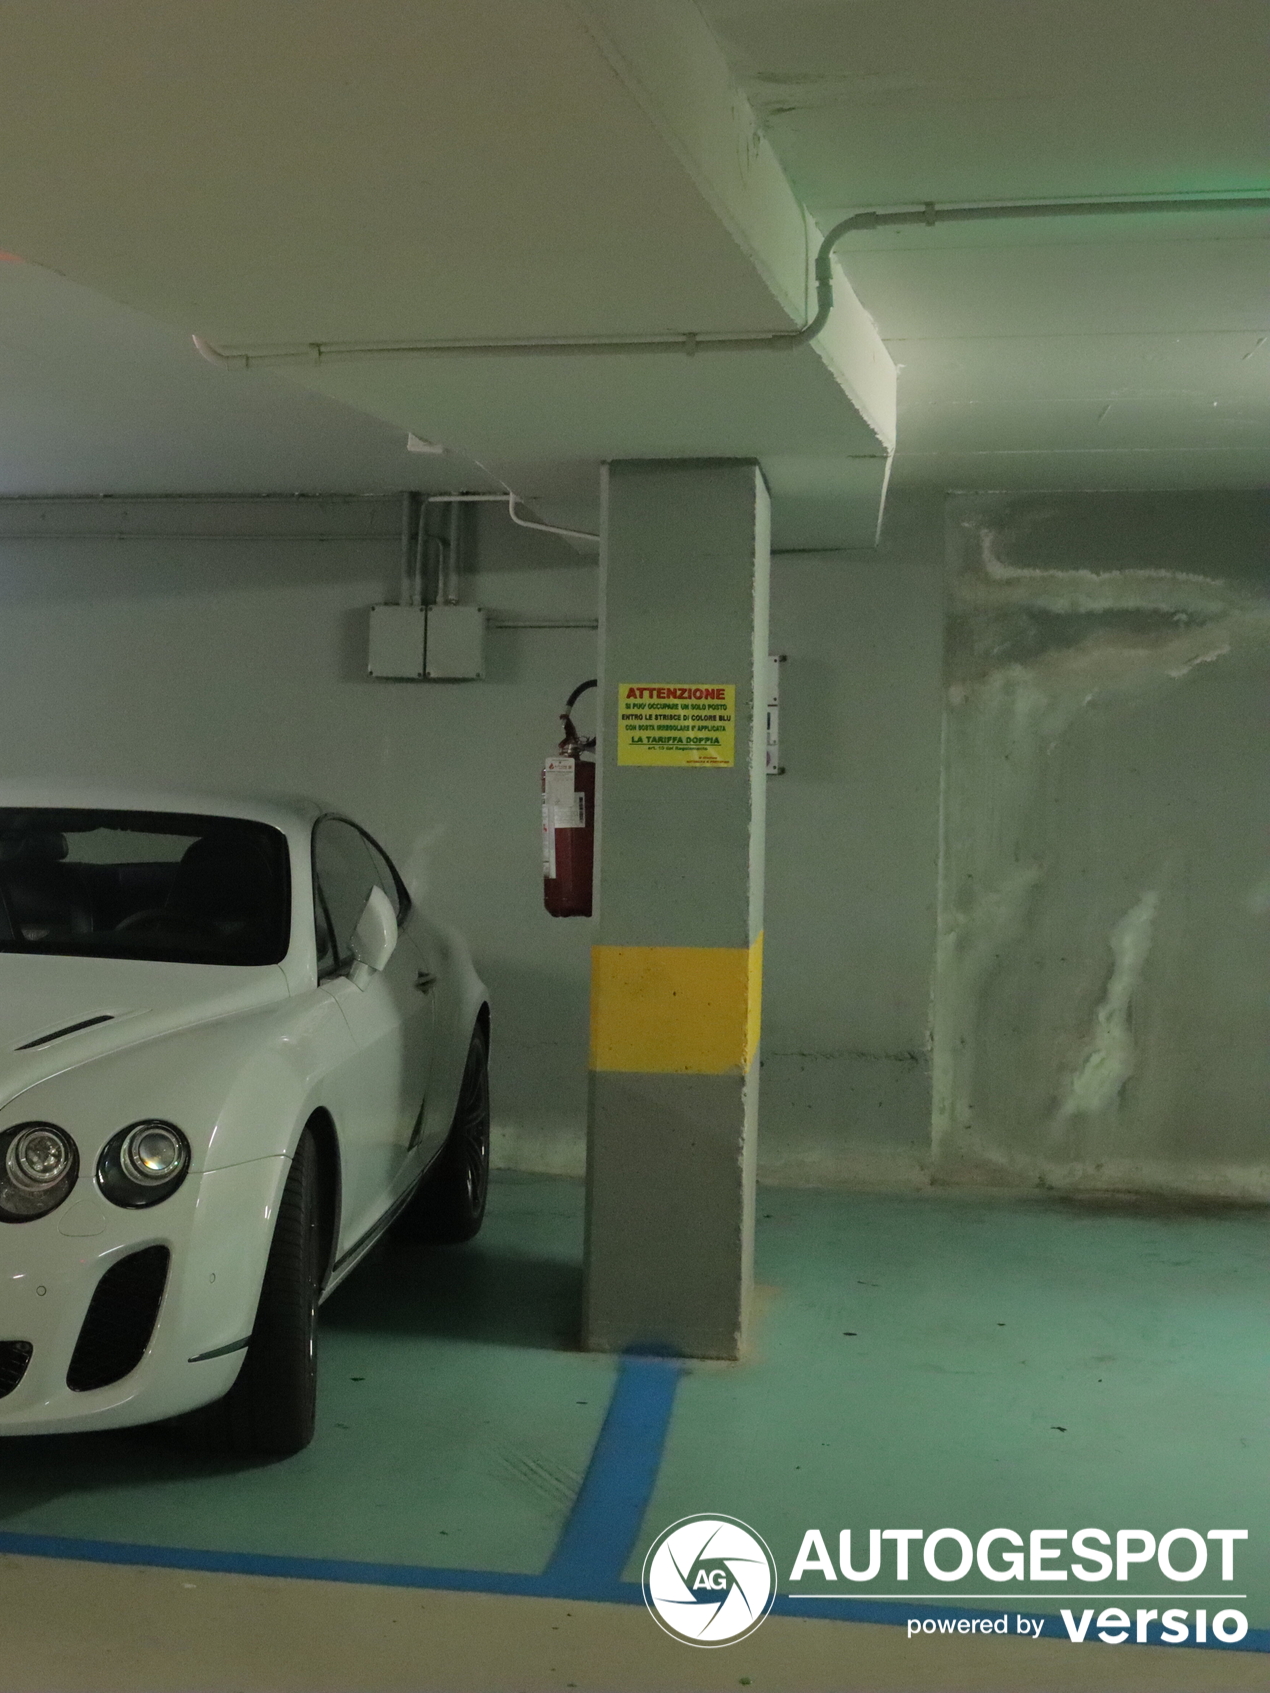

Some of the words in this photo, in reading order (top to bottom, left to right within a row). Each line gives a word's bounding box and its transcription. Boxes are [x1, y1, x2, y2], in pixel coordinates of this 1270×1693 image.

[626, 687, 725, 700] ATTENZIONE
[680, 703, 689, 711] UN
[646, 736, 683, 744] TARIFFA
[686, 736, 720, 744] DOPPIA
